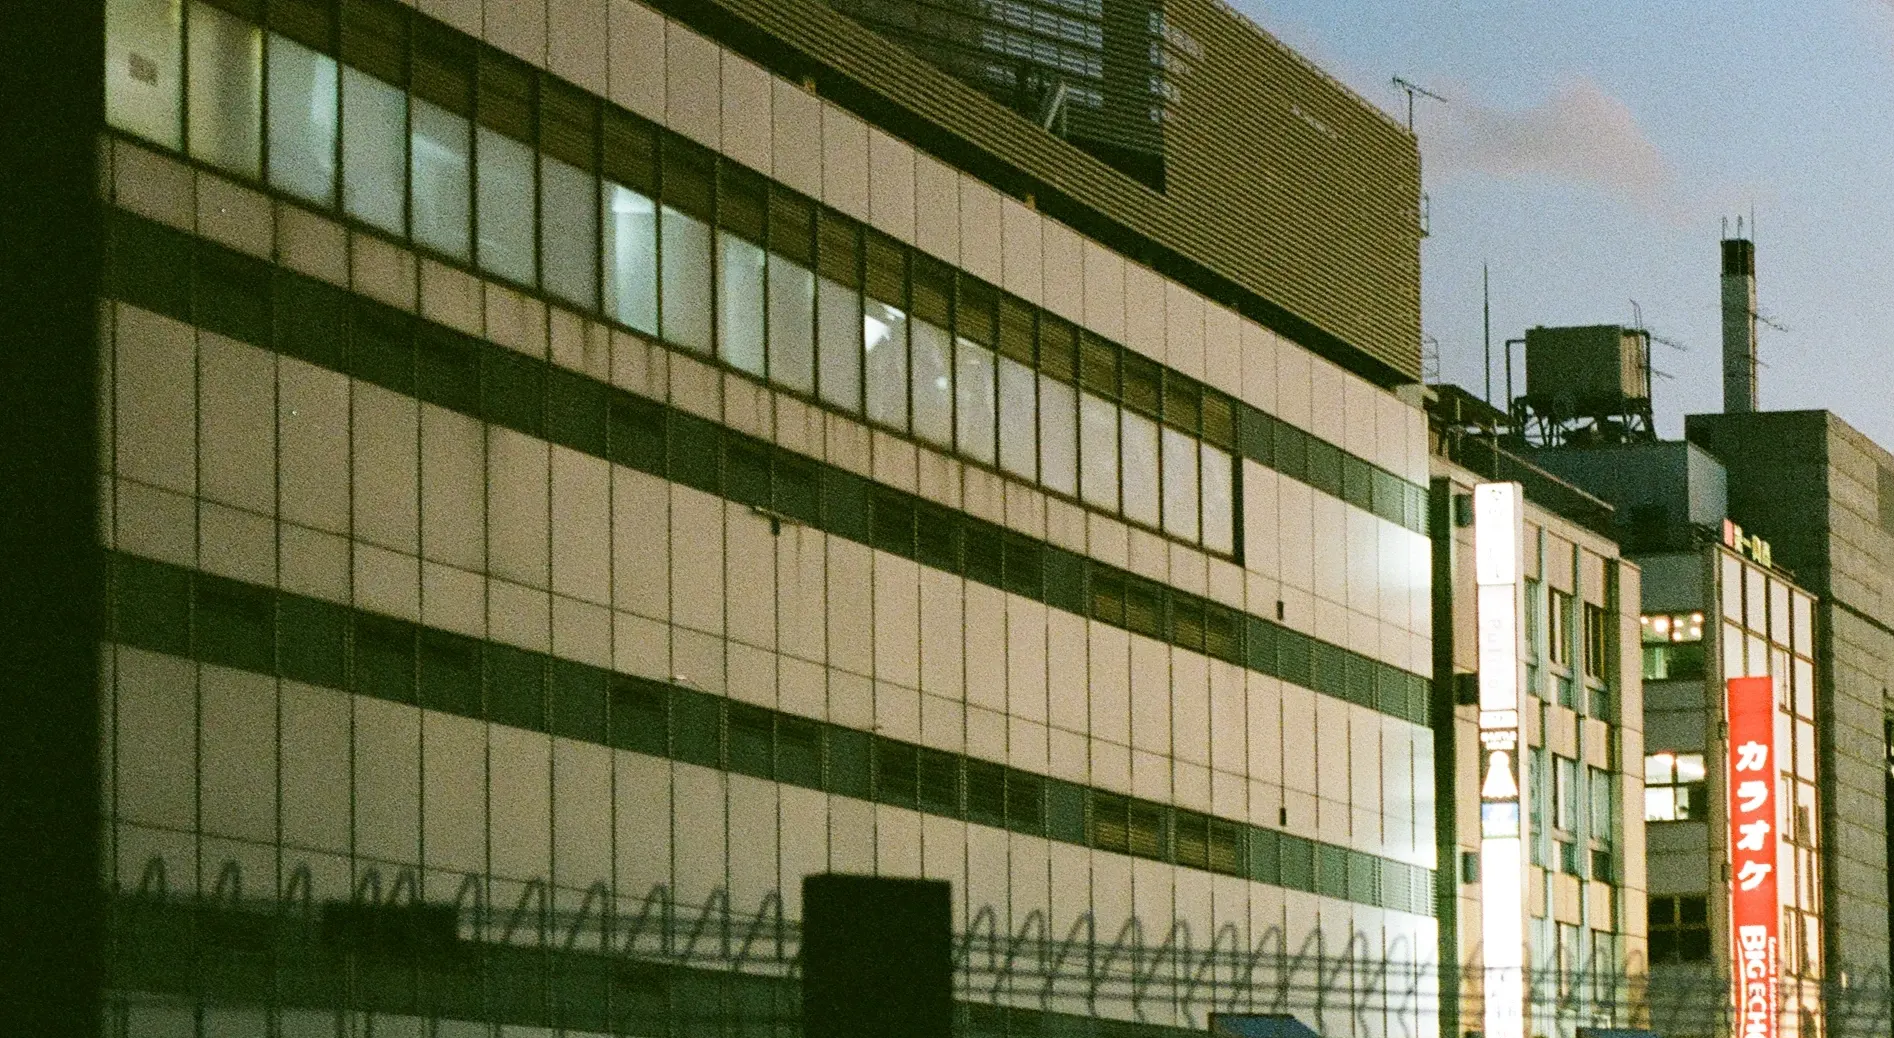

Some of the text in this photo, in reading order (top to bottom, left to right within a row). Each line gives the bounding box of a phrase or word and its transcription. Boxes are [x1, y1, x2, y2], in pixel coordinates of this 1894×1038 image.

[1736, 740, 1772, 892] カラオケ
[1739, 925, 1767, 979] BIG
